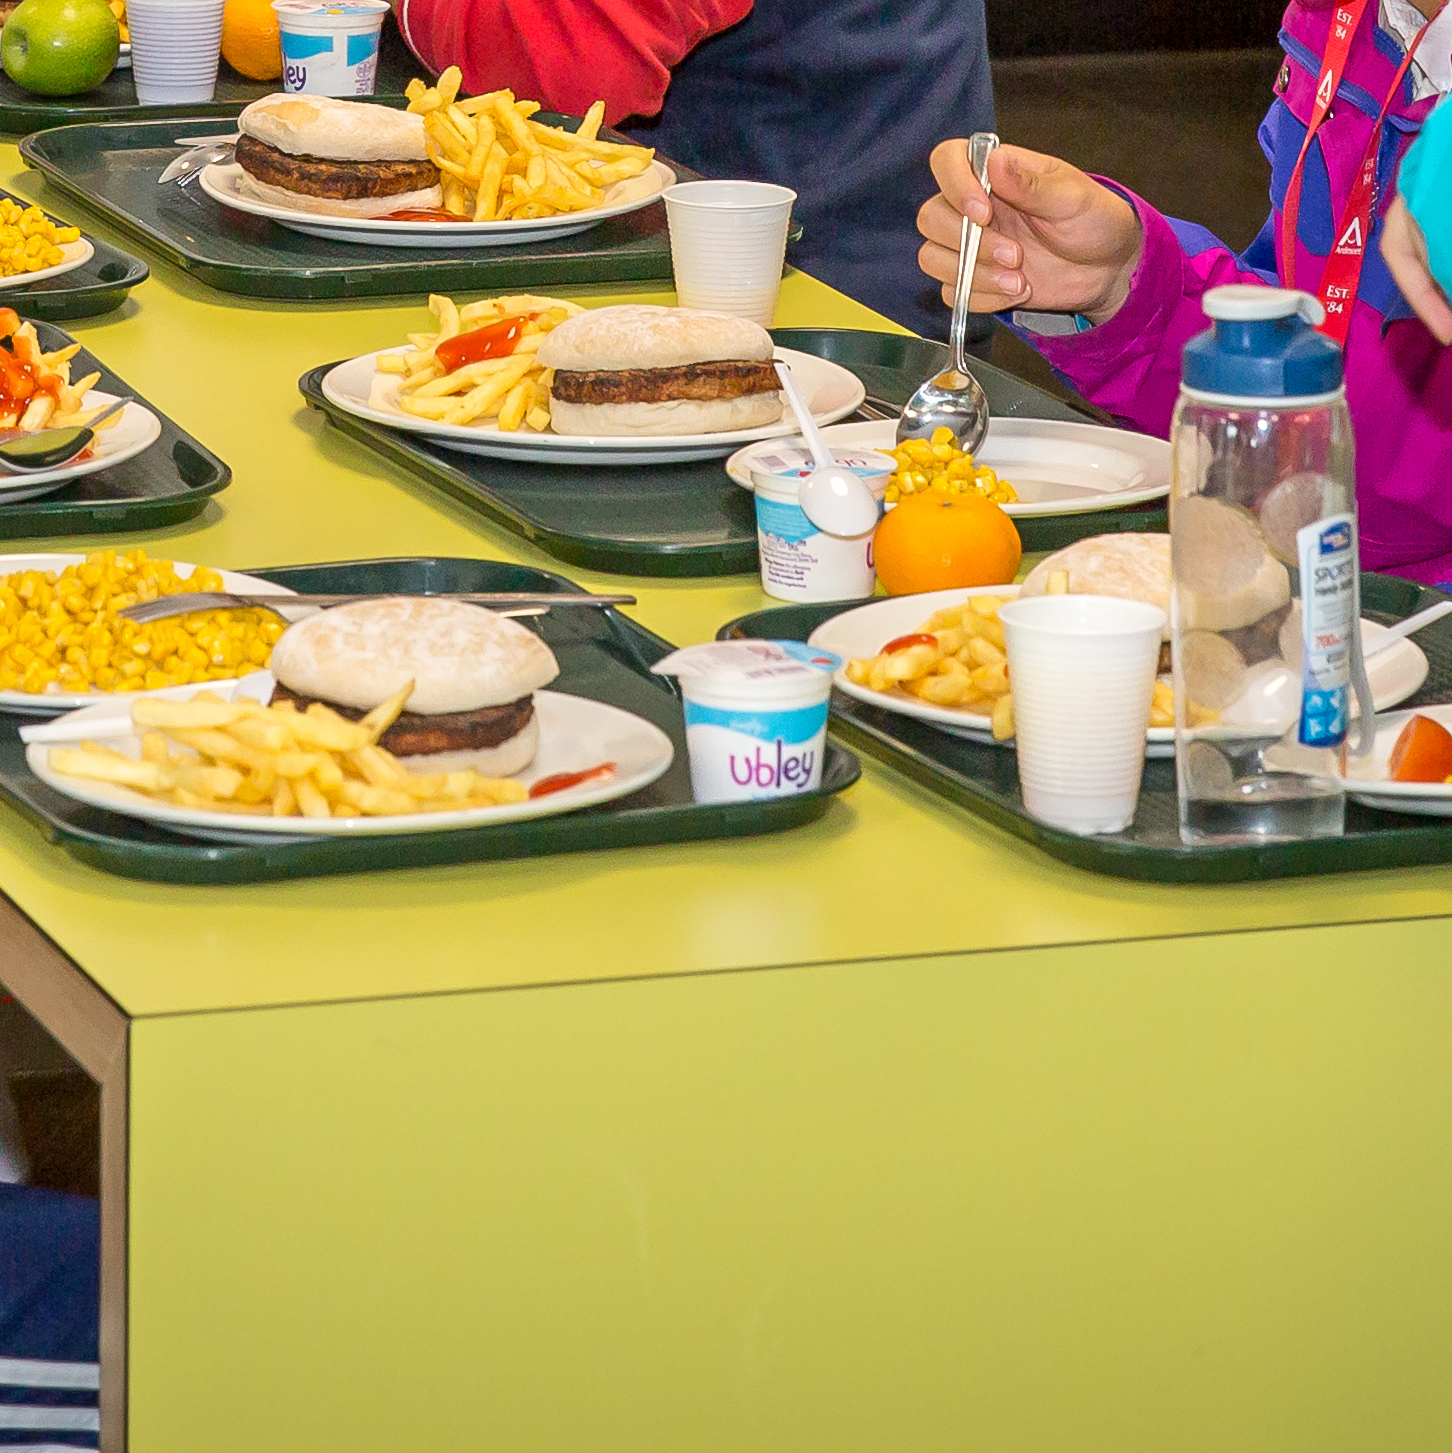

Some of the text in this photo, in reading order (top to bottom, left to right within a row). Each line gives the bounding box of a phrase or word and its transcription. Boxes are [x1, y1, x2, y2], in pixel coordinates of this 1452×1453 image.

[1326, 284, 1350, 300] EST.
[1326, 300, 1343, 315] '84
[729, 739, 814, 788] ubley
